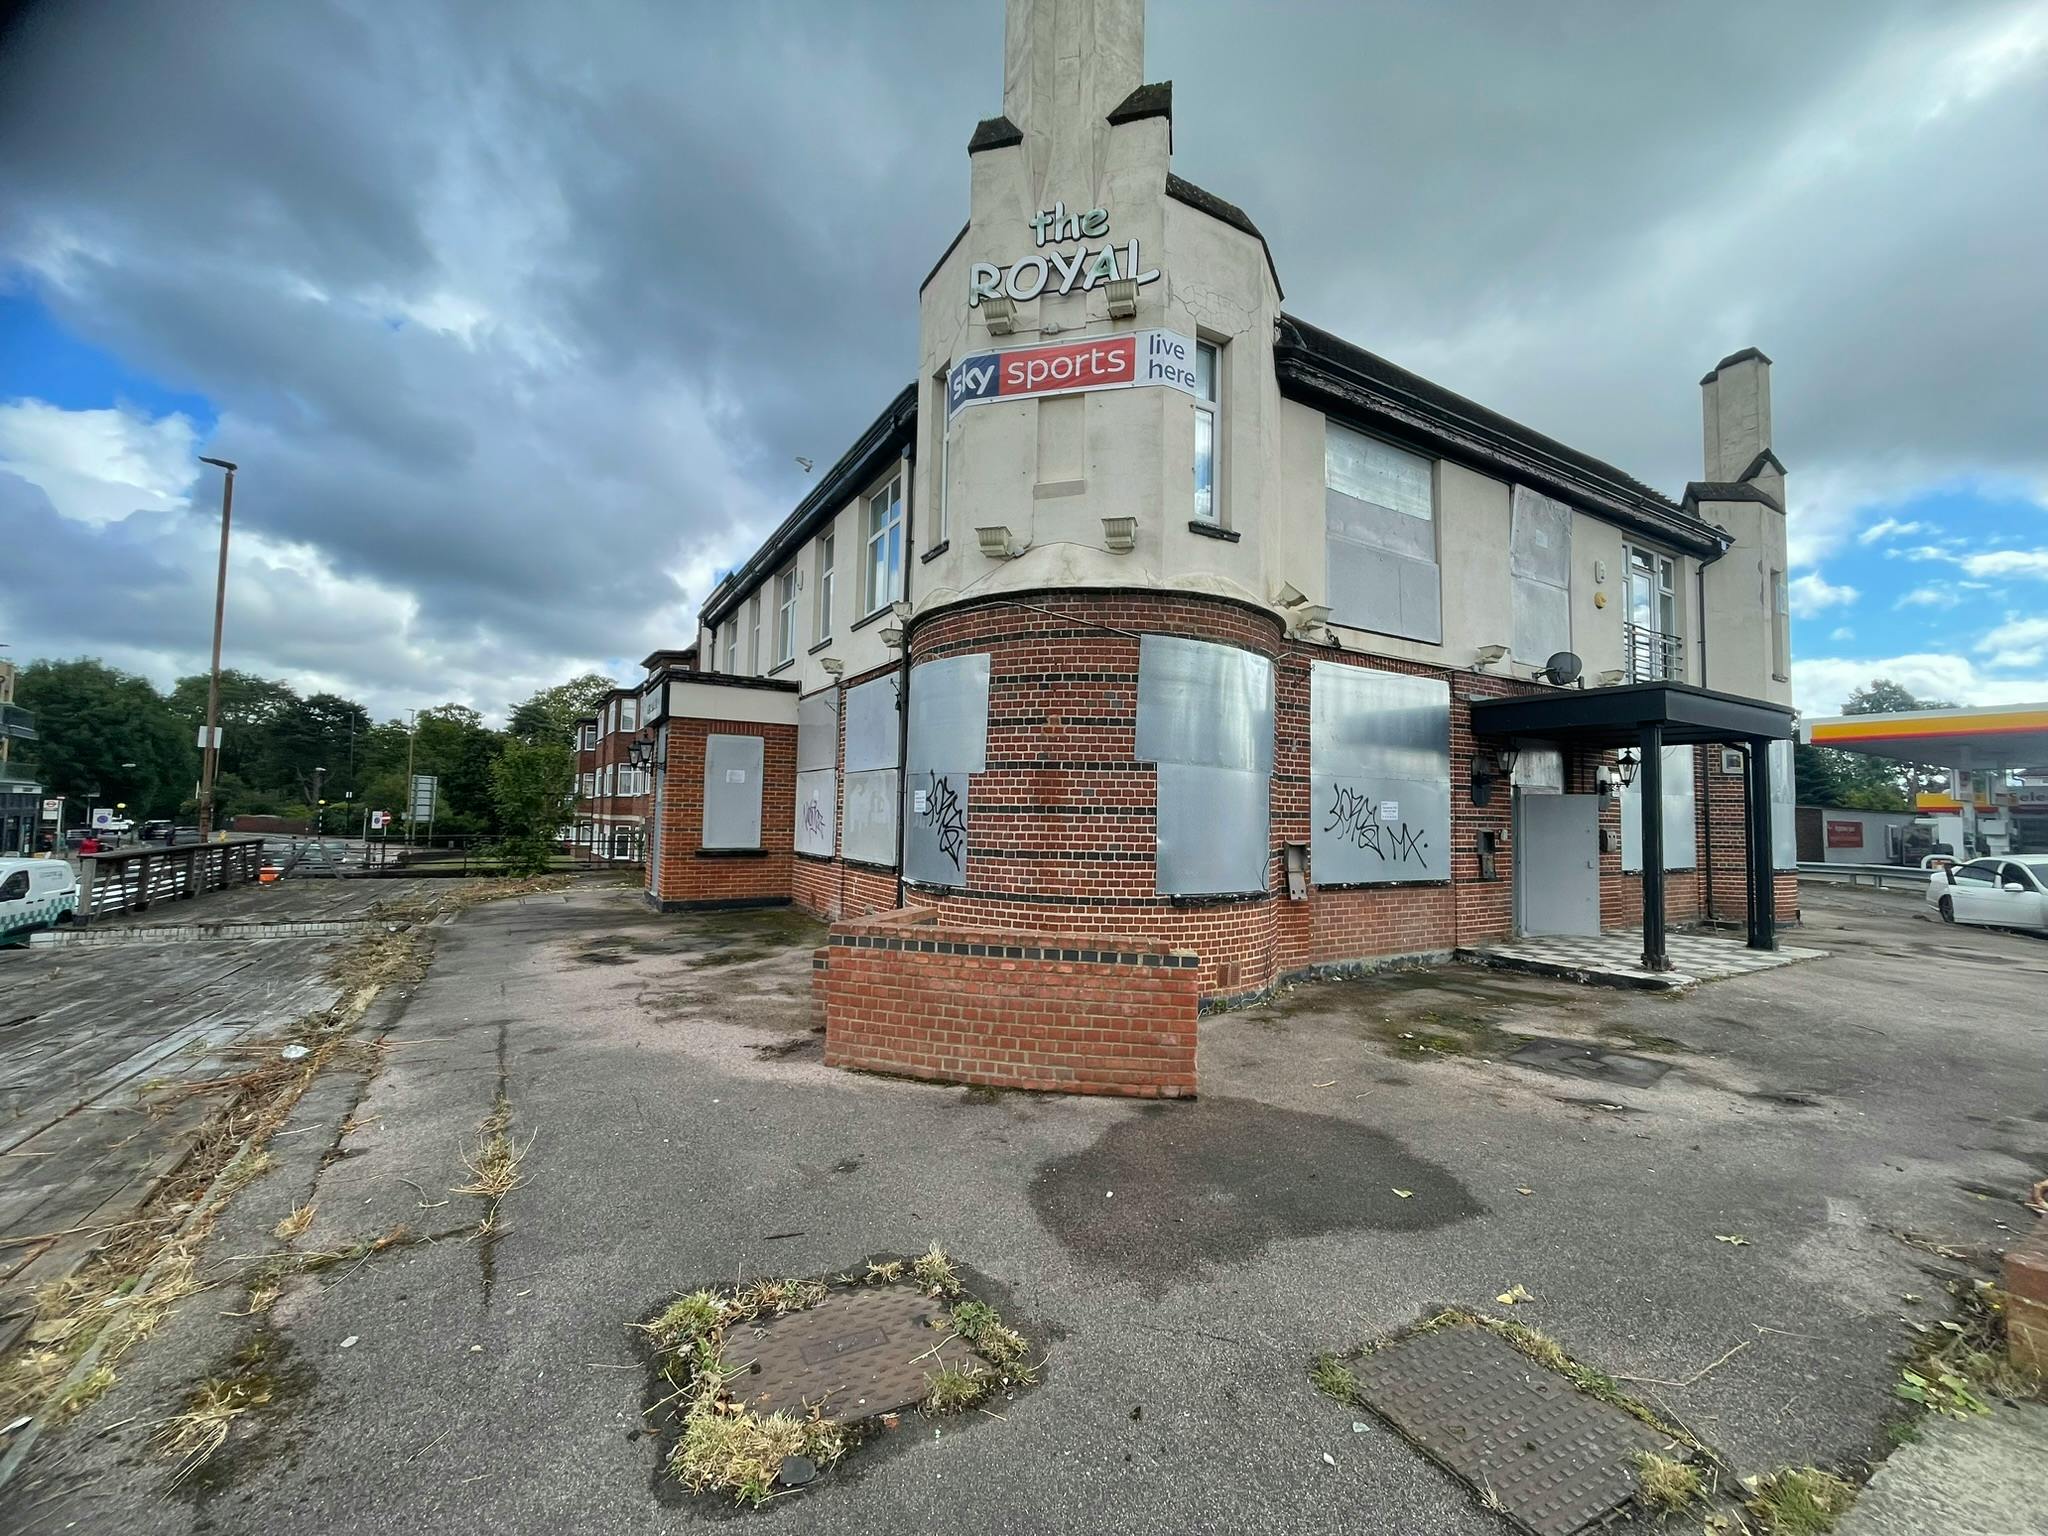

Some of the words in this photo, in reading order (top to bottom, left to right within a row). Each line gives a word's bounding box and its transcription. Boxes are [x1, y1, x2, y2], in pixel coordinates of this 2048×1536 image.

[1029, 200, 1109, 247] the
[968, 238, 1161, 308] ROYAL
[1149, 333, 1185, 361] live
[953, 363, 995, 400] sky
[1007, 348, 1126, 389] sports
[1149, 360, 1195, 389] here
